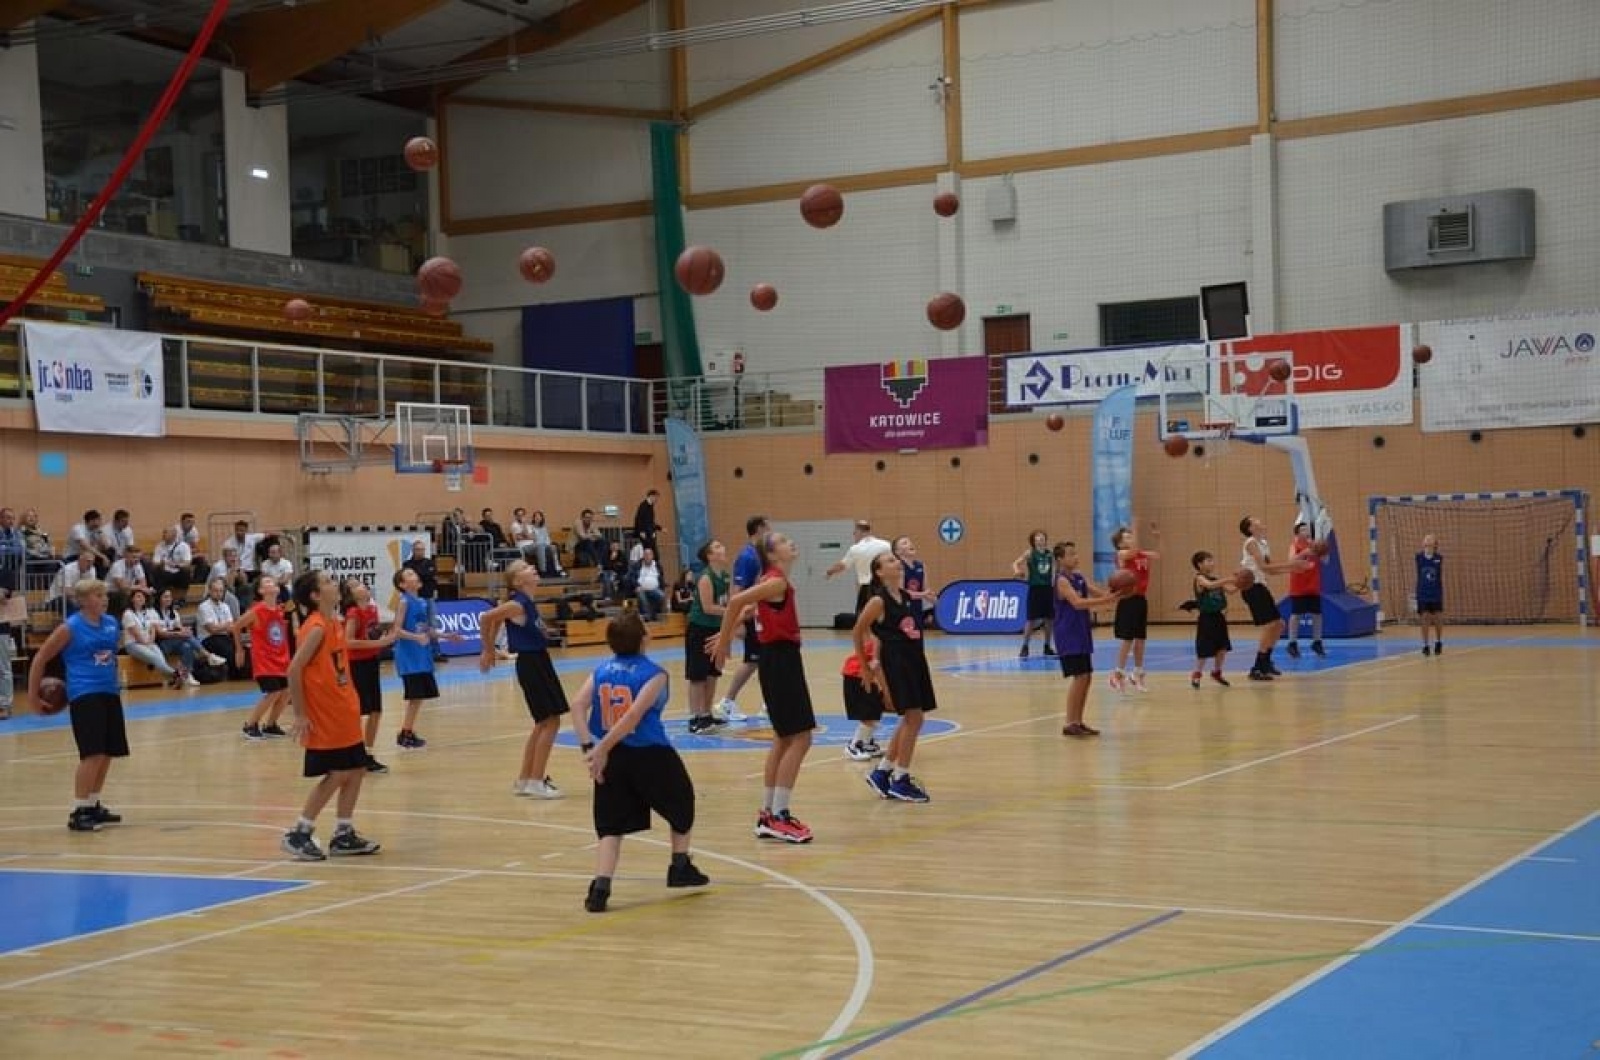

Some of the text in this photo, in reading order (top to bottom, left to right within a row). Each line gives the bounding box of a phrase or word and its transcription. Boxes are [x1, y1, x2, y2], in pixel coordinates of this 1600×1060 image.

[65, 362, 93, 391] nba
[869, 412, 941, 428] KATOWICE
[323, 556, 376, 570] PROJEKT
[987, 591, 1019, 619] nba
